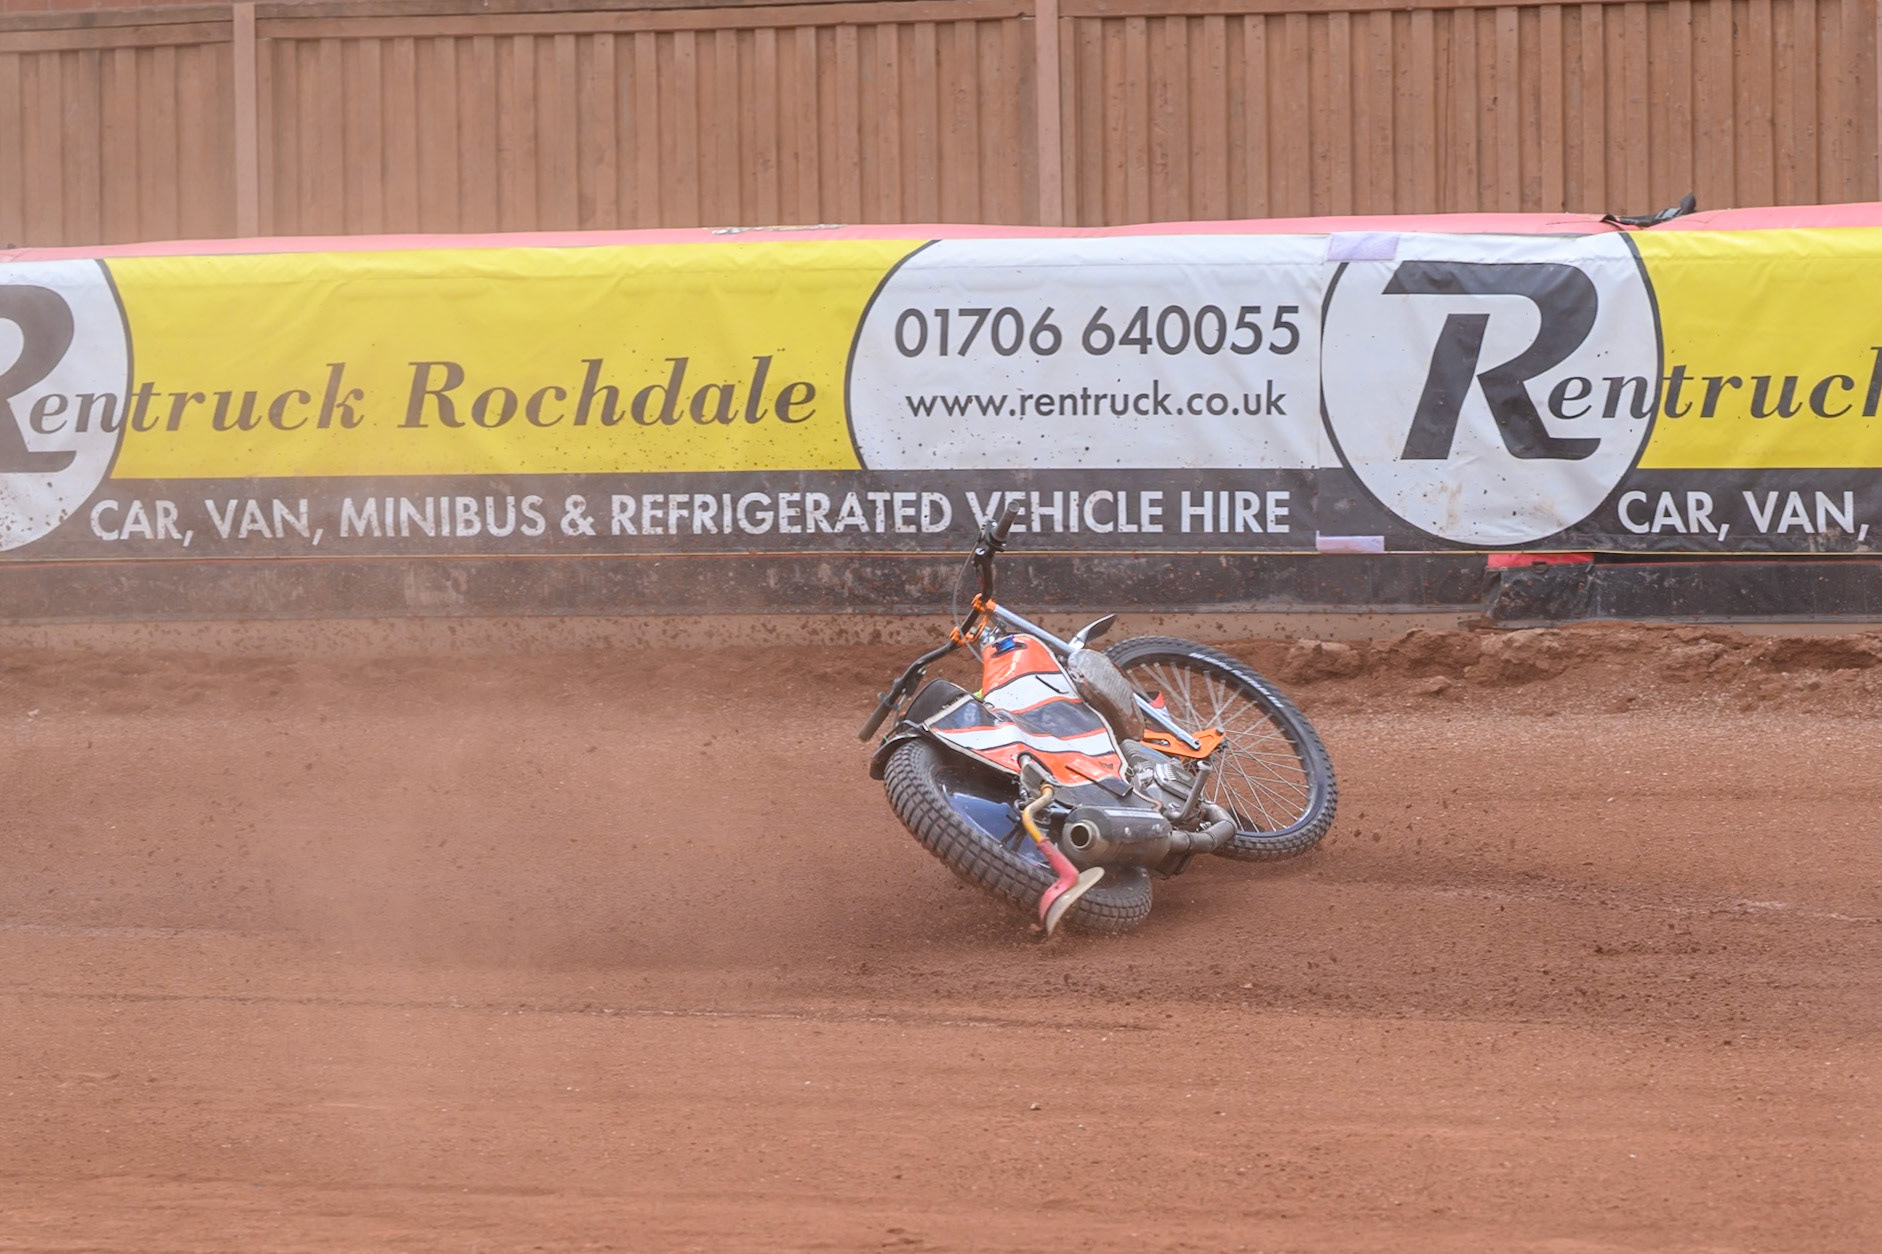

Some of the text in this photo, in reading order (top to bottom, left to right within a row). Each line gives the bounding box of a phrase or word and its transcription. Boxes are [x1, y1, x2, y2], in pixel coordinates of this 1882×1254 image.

[896, 304, 1301, 357] 01706 640055
[397, 355, 817, 433] Rochdale
[905, 380, 1287, 417] www.rentruck.co.uk
[90, 490, 1291, 546] CAR, VAN, MINIBUS & REFRIGERATED VEHICLE HIRE
[1617, 491, 1869, 542] CAR, VAN,
